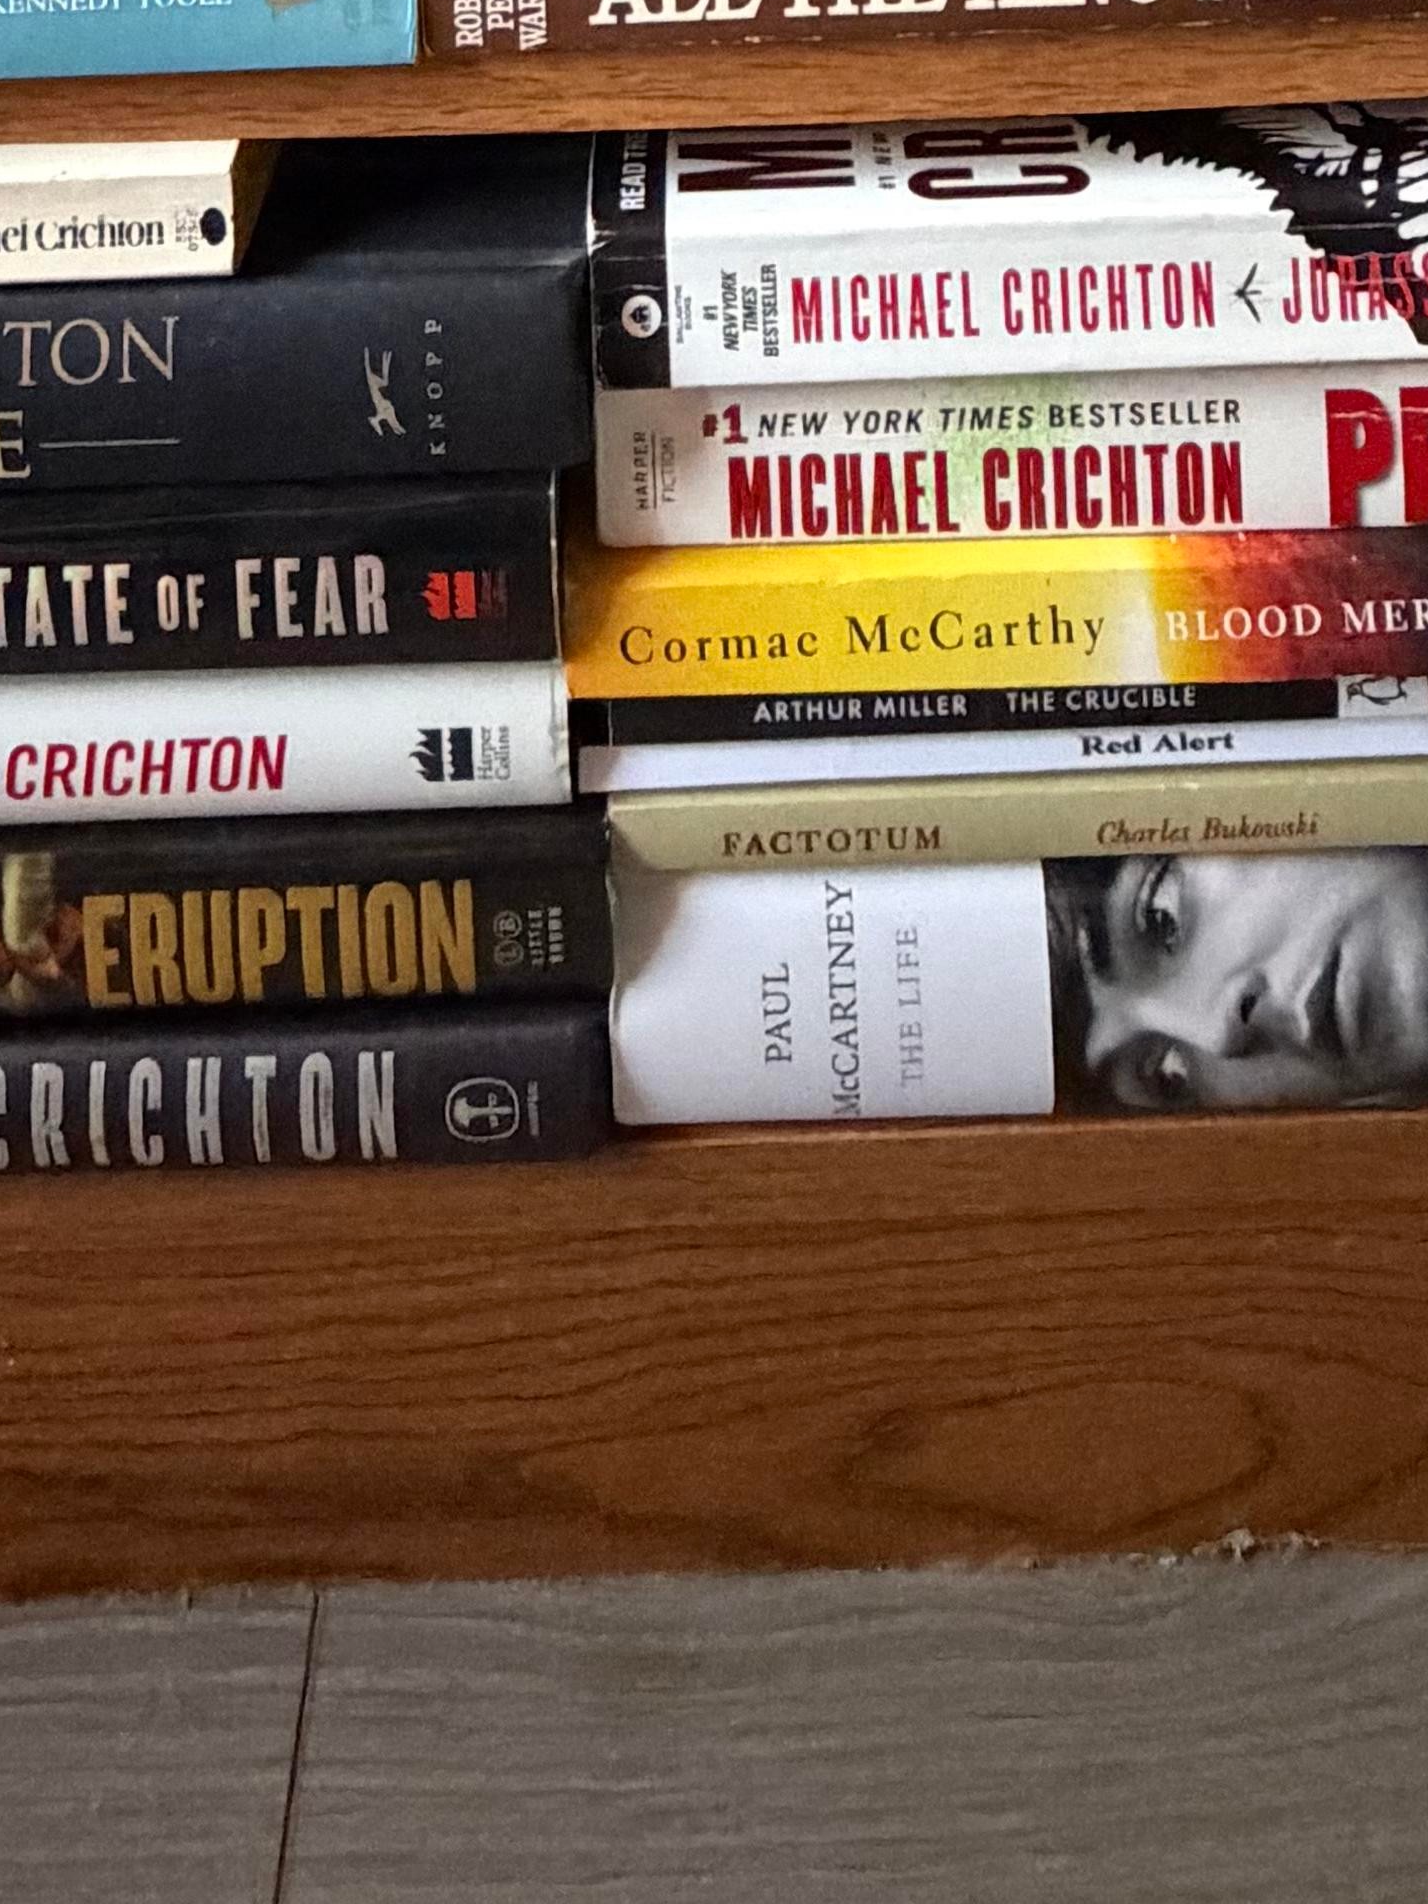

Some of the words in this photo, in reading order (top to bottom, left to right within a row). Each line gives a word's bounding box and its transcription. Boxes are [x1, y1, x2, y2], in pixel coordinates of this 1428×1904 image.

[701, 403, 749, 445] #1
[757, 406, 831, 438] NEW
[843, 404, 928, 435] YORK
[939, 403, 1037, 432] TIMES
[1048, 398, 1243, 429] BESTSELLER
[727, 448, 961, 540] MICHAEL
[982, 439, 1245, 530] CRICHTON
[154, 576, 207, 633] OF
[234, 554, 391, 640] FEAR
[1164, 604, 1325, 645] BLOOD
[618, 618, 821, 666] Cormac
[844, 603, 1106, 659] McCarthy
[2, 735, 288, 803] CRICHTON
[1080, 733, 1140, 760] Red
[1147, 727, 1236, 755] Alert
[722, 823, 944, 861] FACTOTUM
[81, 880, 478, 1008] ERUPTION
[762, 960, 796, 1065] PAUL
[824, 880, 862, 1116] McCARTNEY
